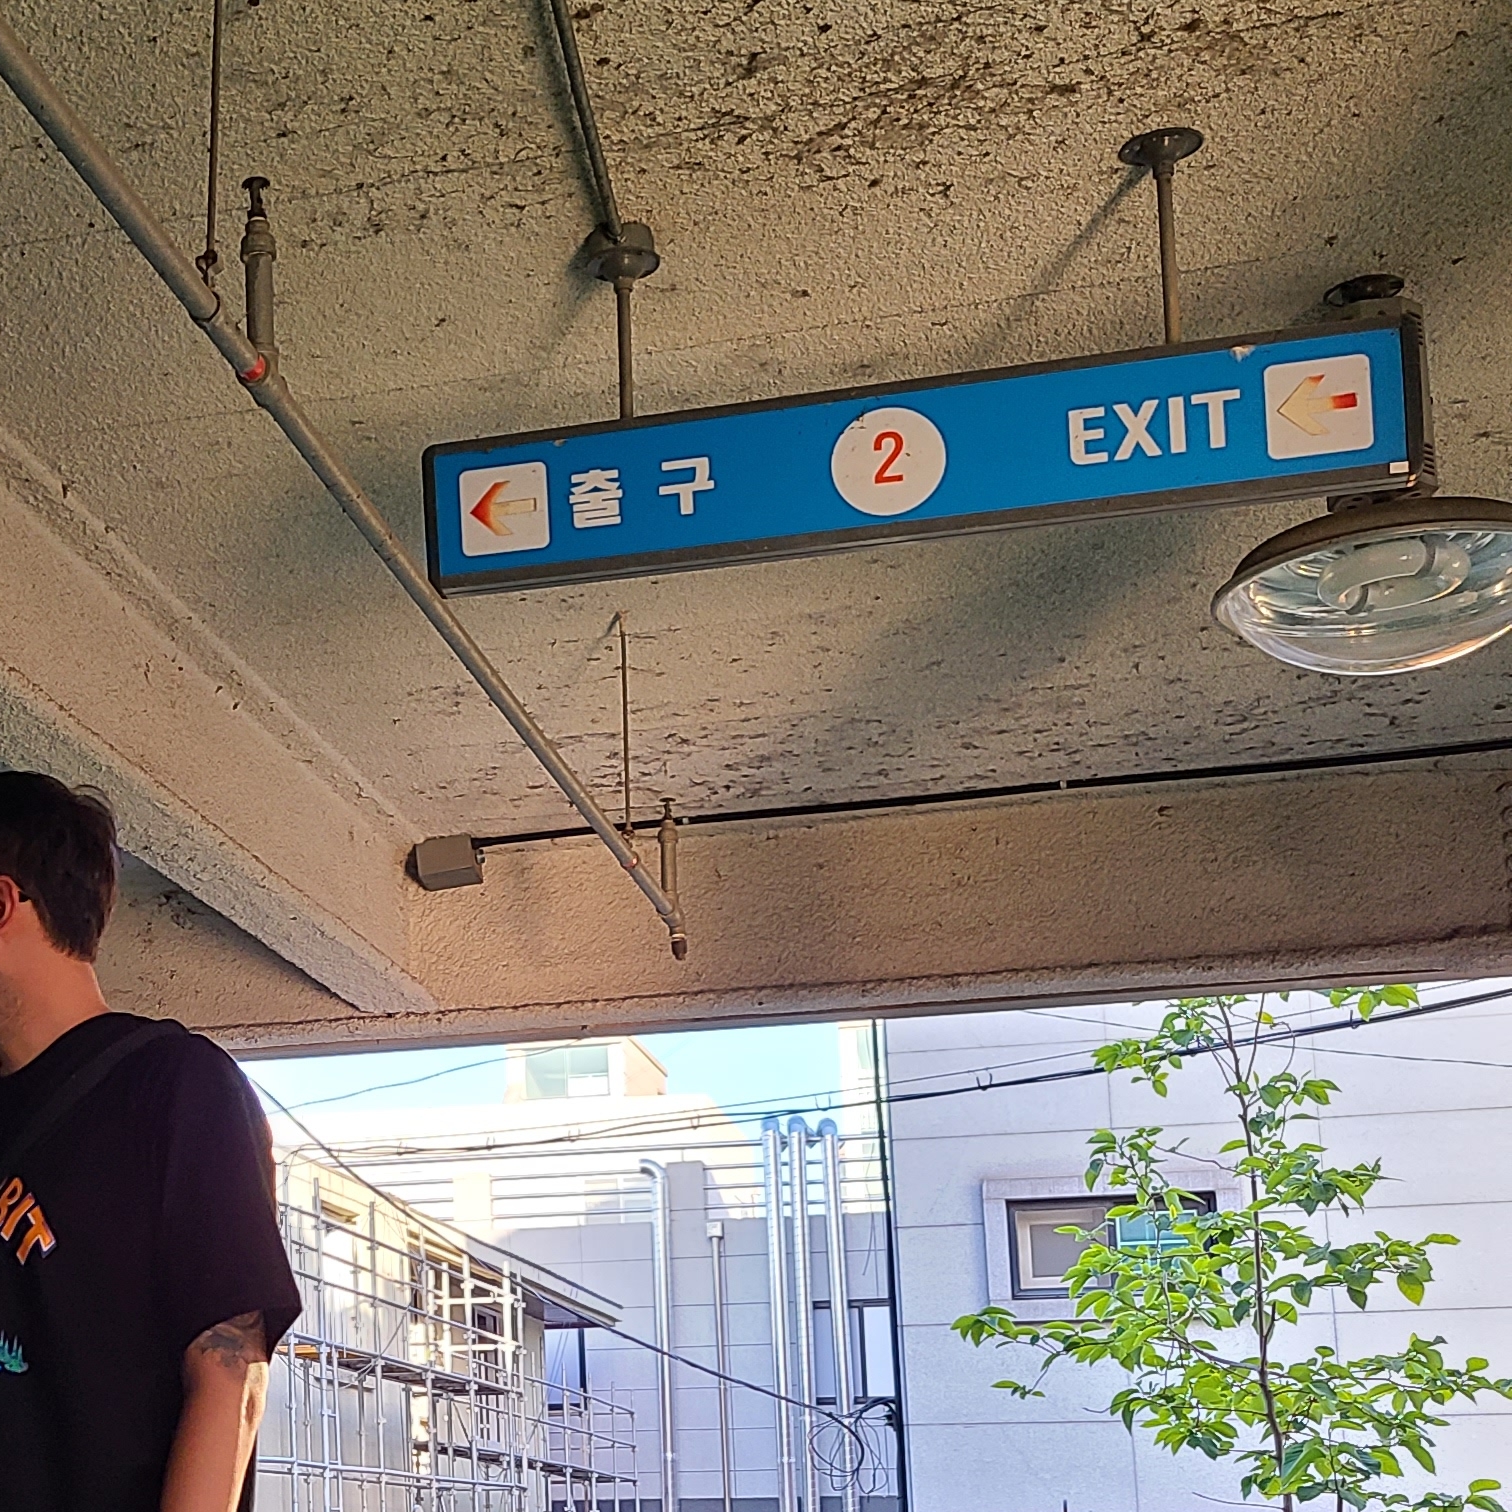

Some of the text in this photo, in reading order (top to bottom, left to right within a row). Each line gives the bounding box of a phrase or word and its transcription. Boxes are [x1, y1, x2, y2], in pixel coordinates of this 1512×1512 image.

[568, 387, 1242, 530] 출구 2 EXIT
